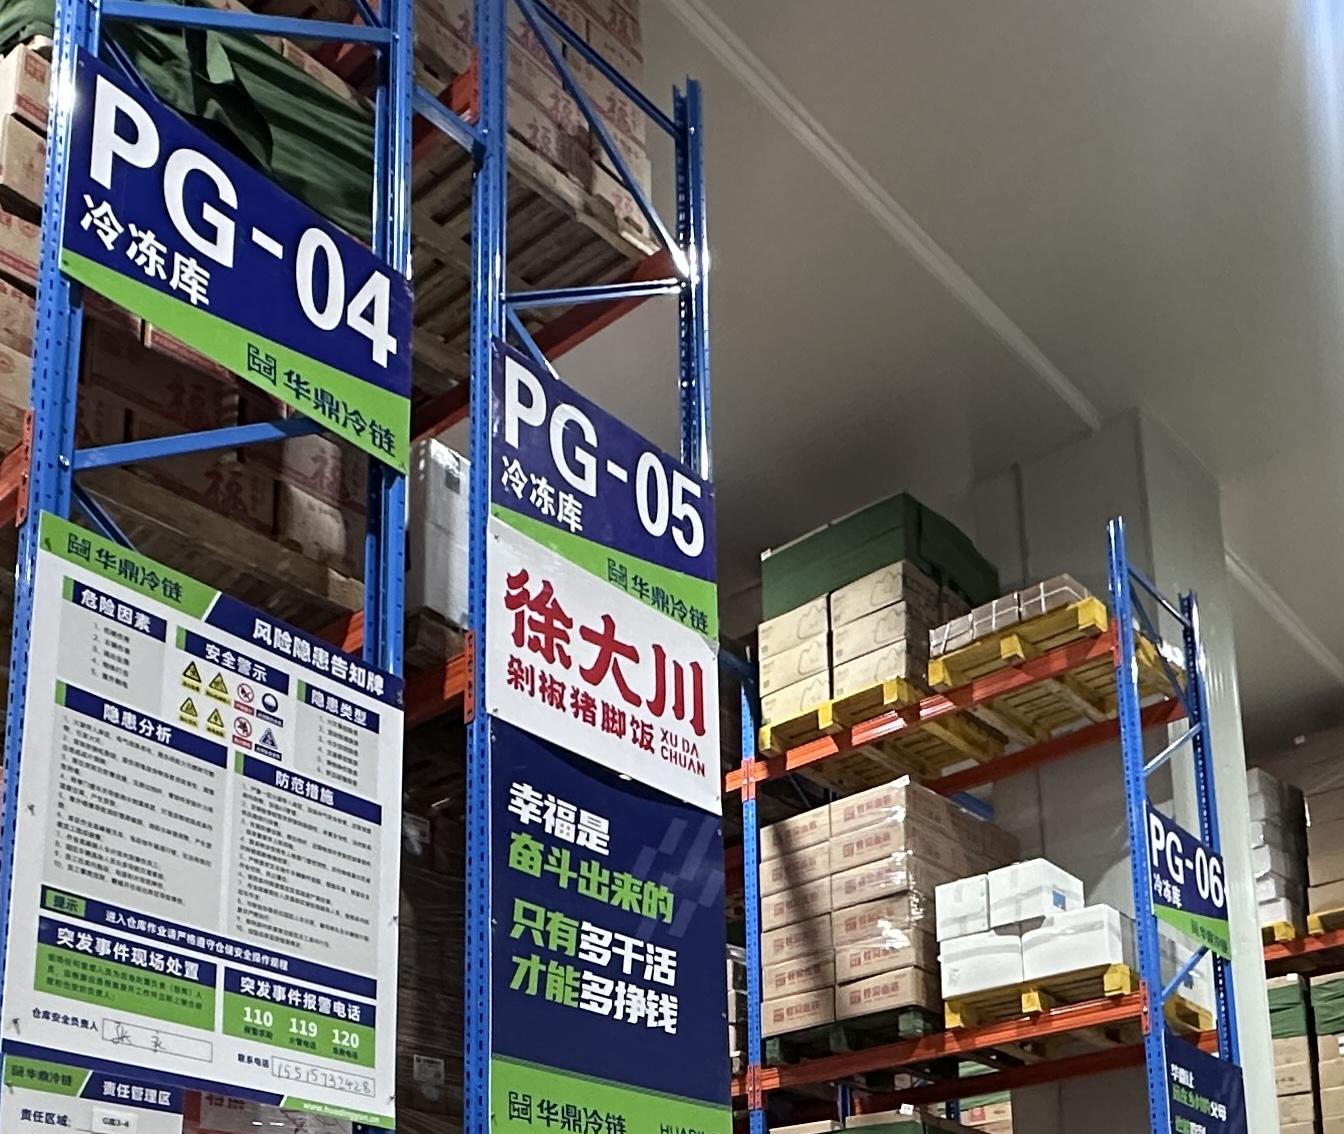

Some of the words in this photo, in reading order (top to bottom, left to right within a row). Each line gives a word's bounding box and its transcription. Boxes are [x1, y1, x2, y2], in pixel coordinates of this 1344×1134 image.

[81, 195, 211, 307] 冷冻库
[89, 74, 398, 368] PG-04
[284, 369, 398, 457] 华鼎冷链
[504, 354, 706, 558] PG-05
[501, 454, 584, 533] 冷冻库
[95, 546, 183, 602] 华鼎冷链
[631, 574, 709, 635] 华鼎冷链
[80, 588, 151, 634] 危险因素
[205, 643, 267, 683] 安全警示
[253, 618, 385, 697] 风险隐患告知牌
[504, 567, 707, 737] 徐大川
[103, 703, 172, 744] 隐患分析
[311, 690, 368, 727] 隐患类型
[506, 653, 655, 755] 剁椒猪脚饭
[660, 727, 678, 749] XU
[681, 737, 700, 760] DA
[660, 746, 706, 778] CHUAN
[275, 770, 335, 806] 防范措施
[508, 782, 610, 856] 幸福是
[508, 832, 675, 924] 奋斗出来的
[1149, 812, 1225, 908] PG-06
[57, 926, 200, 981] 突发事件现场处置
[511, 898, 677, 987] 只有多干活
[32, 1007, 99, 1032] 仓库安全负责人
[240, 976, 361, 1022] 突发事件报警电话
[510, 954, 678, 1034] 才能多挣钱
[243, 1007, 273, 1028] 110
[289, 1017, 318, 1037] 119
[332, 1029, 359, 1049] 120
[102, 1080, 171, 1106] 责任管理区
